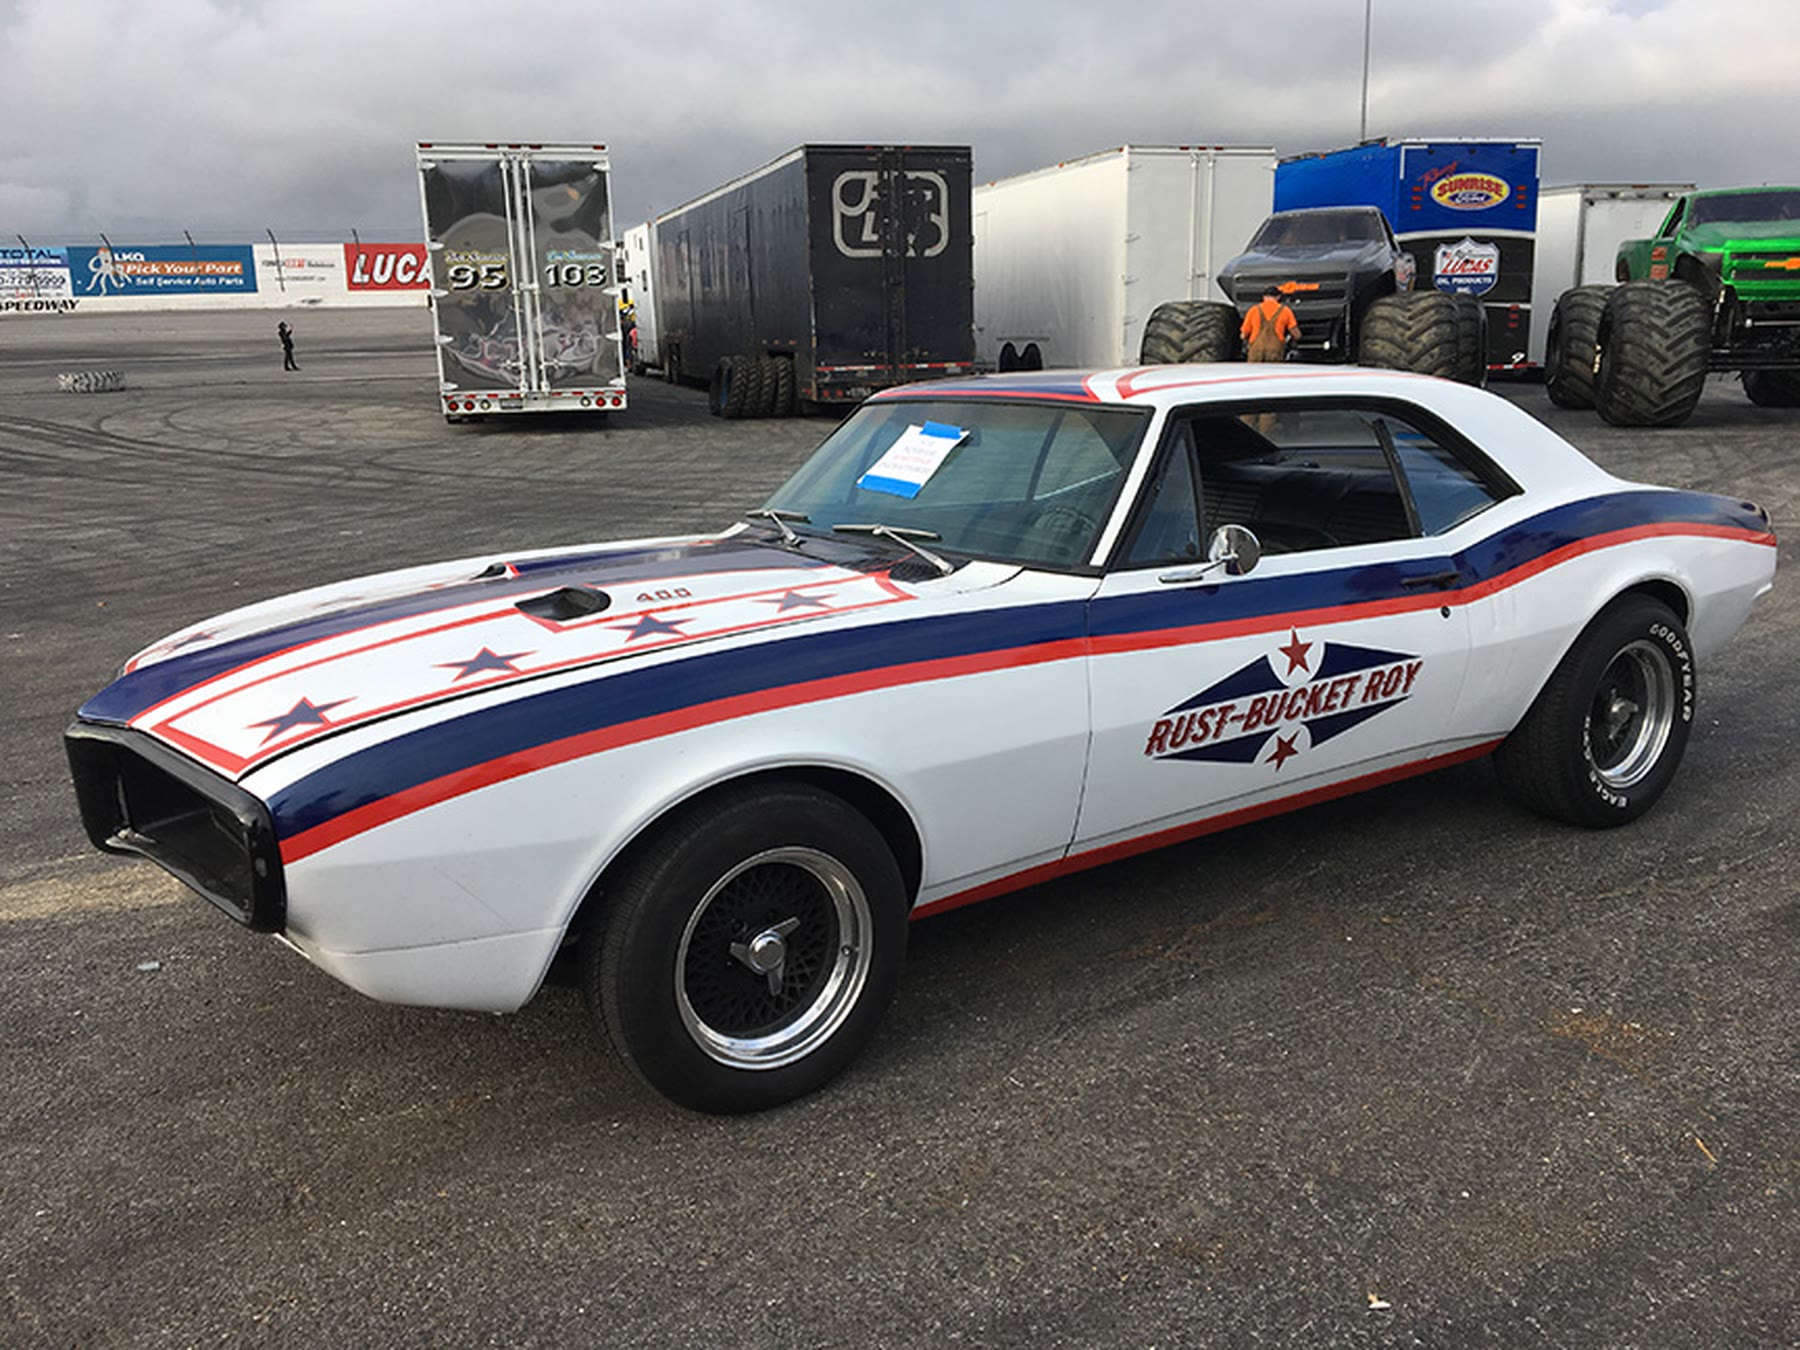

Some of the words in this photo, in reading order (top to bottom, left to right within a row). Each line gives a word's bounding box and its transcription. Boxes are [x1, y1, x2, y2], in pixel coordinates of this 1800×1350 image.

[1437, 177, 1504, 198] SUNRISE
[1455, 192, 1487, 204] Ford
[0, 249, 61, 259] TOTAL
[126, 263, 161, 274] Pick
[164, 263, 200, 274] Your
[206, 263, 241, 274] Part
[1441, 258, 1494, 274] LUCAS
[136, 277, 155, 286] Self
[156, 277, 192, 287] Service
[219, 276, 244, 286] Parts
[448, 263, 512, 292] 95
[544, 263, 608, 288] 103
[1436, 277, 1451, 286] OIL
[1451, 277, 1492, 286] PRODUCTS
[636, 587, 692, 602] 400
[1650, 623, 1693, 722] GOODYEAR
[1144, 675, 1363, 756] RUST-BUCKET
[1361, 660, 1425, 703] ROY
[1589, 770, 1628, 808] EAGLE
